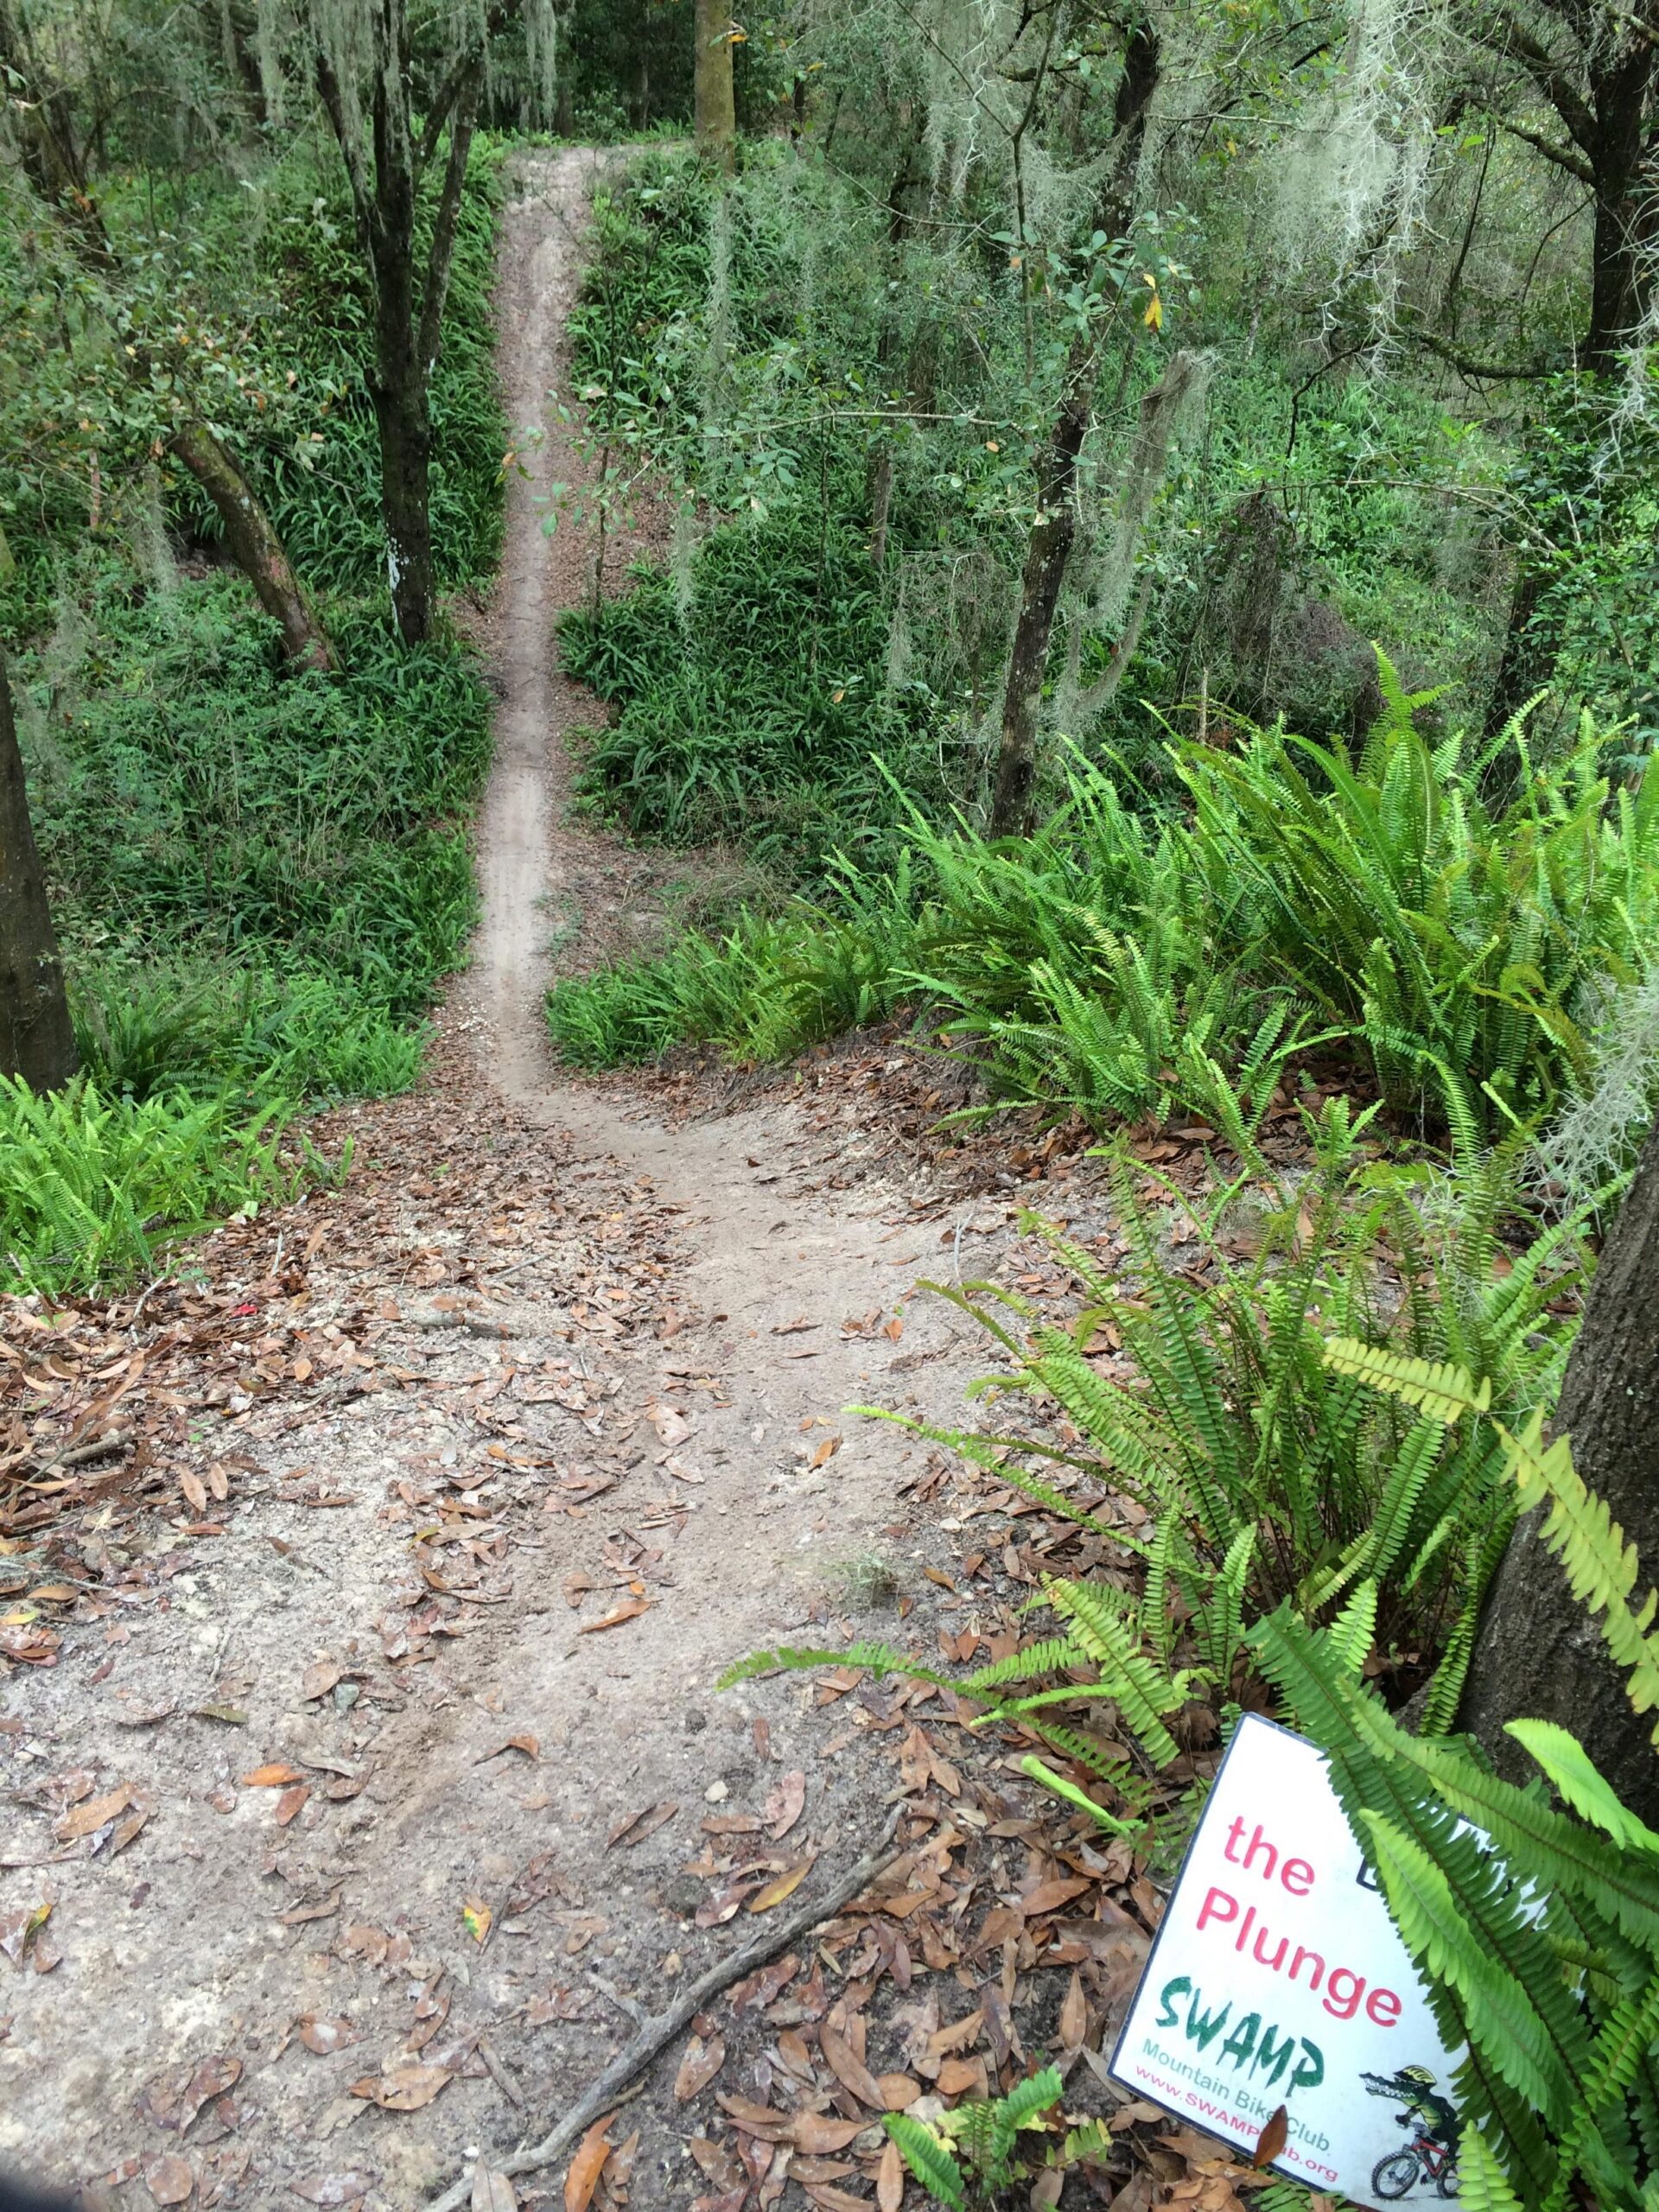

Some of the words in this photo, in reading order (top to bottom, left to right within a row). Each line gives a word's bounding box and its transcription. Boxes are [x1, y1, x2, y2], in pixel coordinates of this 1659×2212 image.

[1224, 1815, 1315, 1896] the
[1197, 1886, 1402, 2027] Plunge
[1141, 2038, 1230, 2100] Mountain
[1154, 1976, 1325, 2098] SWAMP
[1135, 2065, 1338, 2183] www.SWAMPb.org
